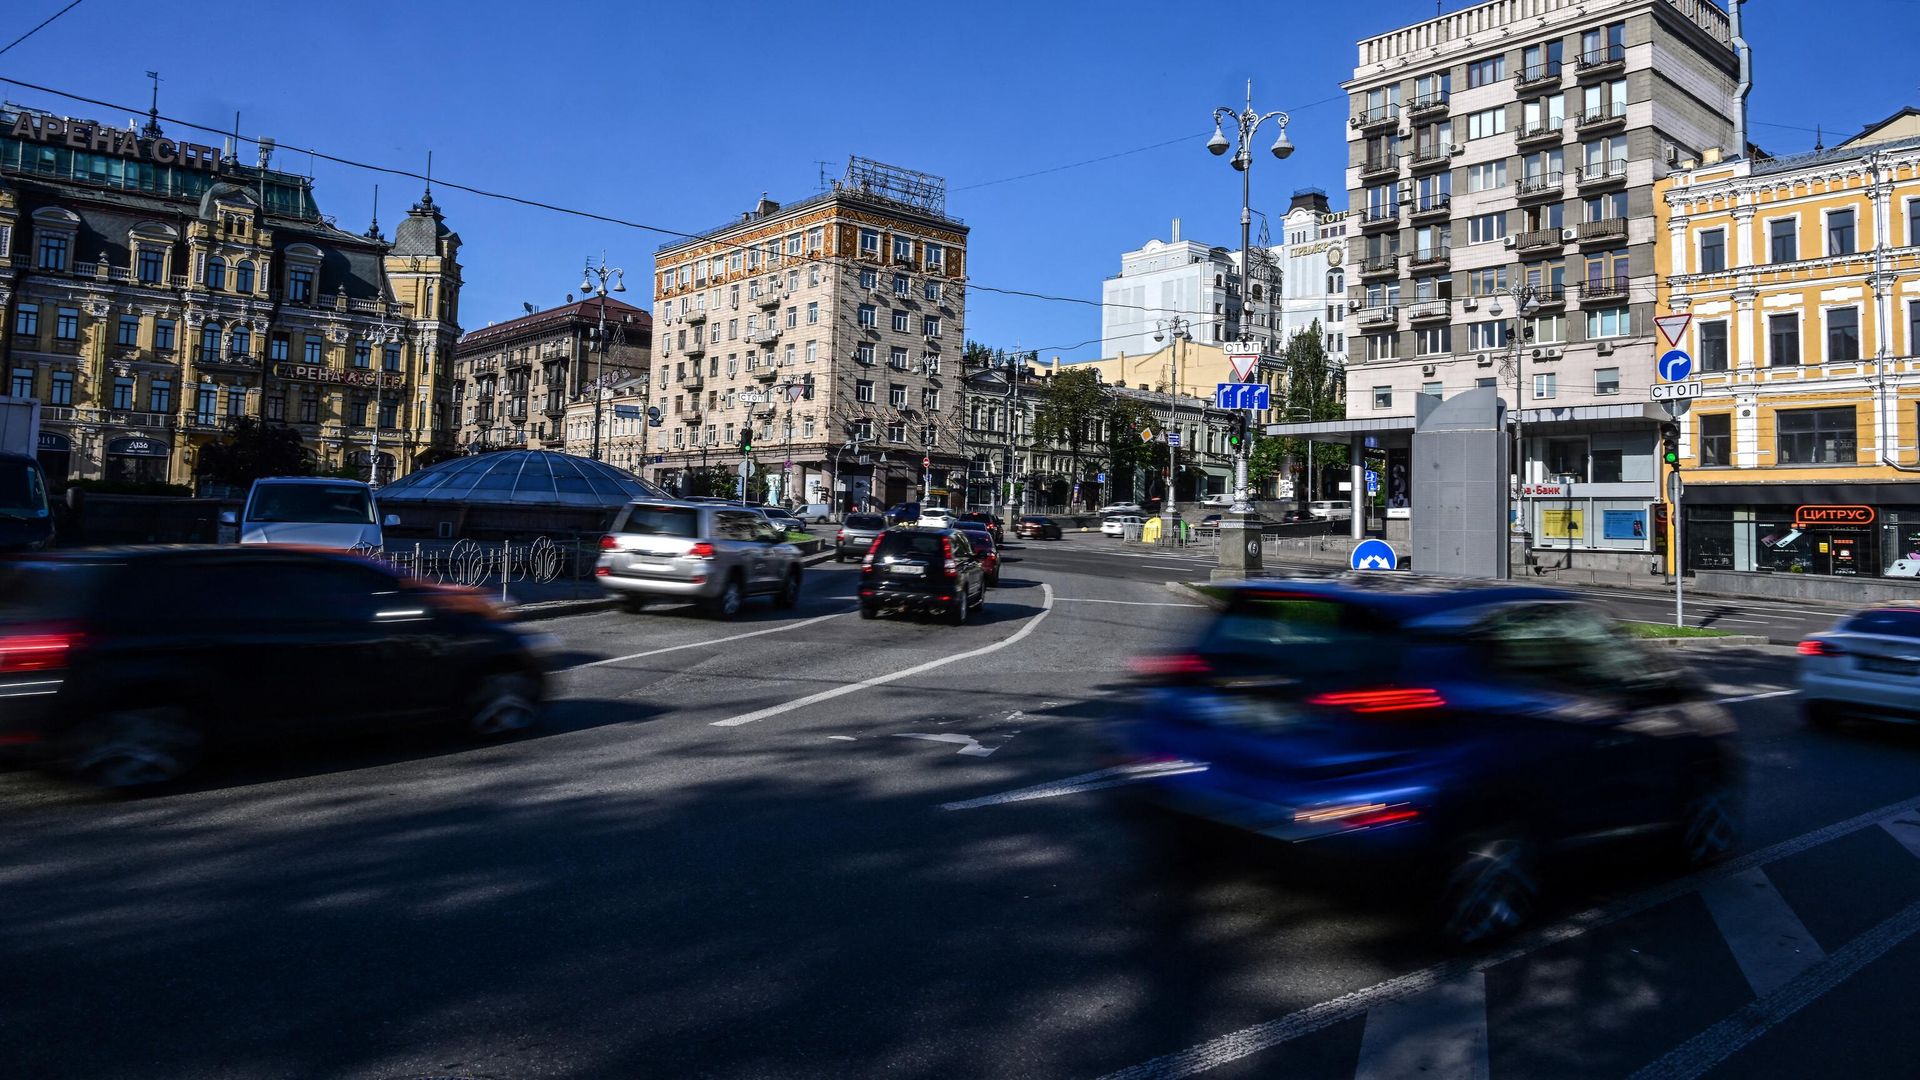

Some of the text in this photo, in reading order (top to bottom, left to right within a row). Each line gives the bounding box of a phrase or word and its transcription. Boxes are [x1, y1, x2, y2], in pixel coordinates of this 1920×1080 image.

[11, 112, 141, 158] АРЕНА
[1225, 342, 1260, 353] СТОП
[284, 365, 341, 382] АРЕНА
[1652, 383, 1699, 398] СТОП
[740, 393, 764, 402] СТОП
[1803, 509, 1867, 521] ЦИТРУС
